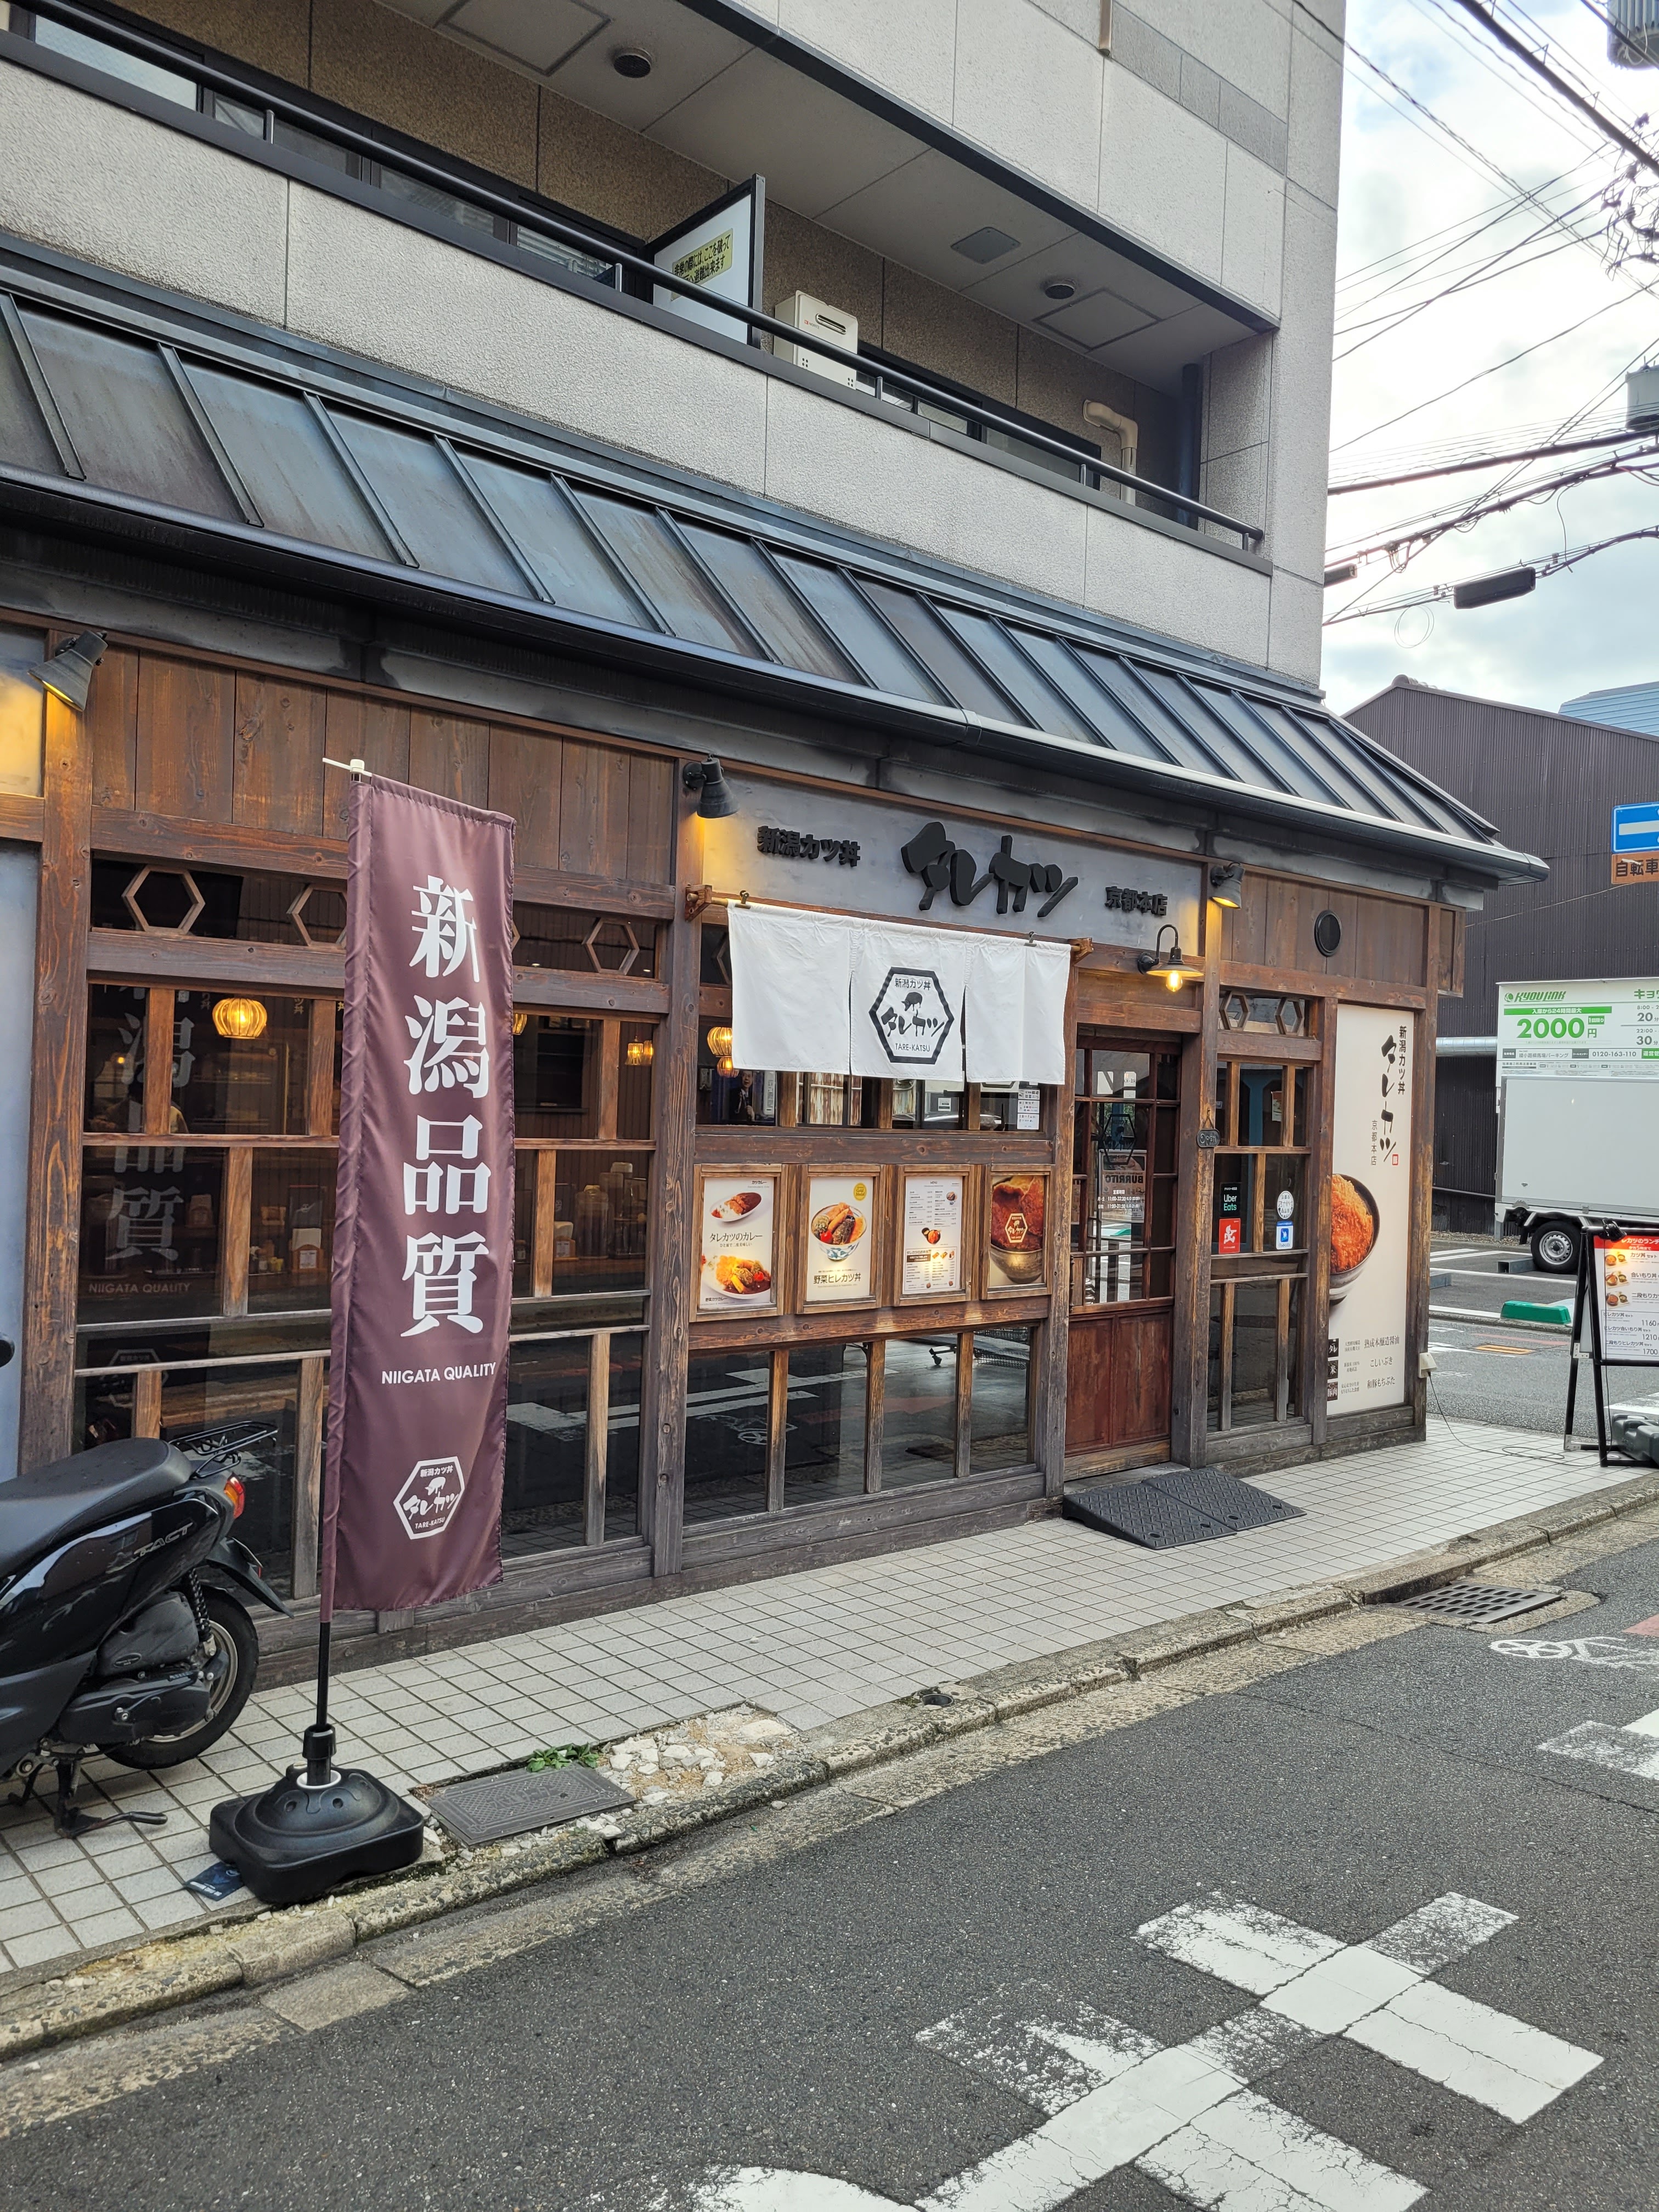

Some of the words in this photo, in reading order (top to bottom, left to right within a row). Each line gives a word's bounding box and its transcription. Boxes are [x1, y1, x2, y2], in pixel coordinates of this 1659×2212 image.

[757, 825, 861, 867] 新潟カツ丼
[901, 821, 1079, 917] タレカツ
[1105, 885, 1168, 916] 京都本店
[894, 978, 931, 991] 新潟カツ丼
[1634, 989, 1659, 999] キョ
[881, 1007, 944, 1037] タレカツ
[1516, 1018, 1584, 1038] 2000
[895, 1043, 930, 1052] TARE-KATSU
[1398, 1025, 1407, 1095] 新潟カツ丼
[1380, 1035, 1396, 1162] タレカツ
[401, 874, 490, 1338] 新潟品質
[1223, 1194, 1238, 1203] Uber
[1223, 1203, 1237, 1211] Eats
[709, 1232, 763, 1243] タレカツのカレー
[813, 1273, 861, 1284] 野菜ヒレカツ丼
[89, 1283, 138, 1293] NIIGATA
[142, 1282, 191, 1293] QUALITY
[1370, 1356, 1393, 1367] こしいぶき
[381, 1368, 441, 1385] NIIGATA
[444, 1362, 496, 1381] QUALITY
[1329, 1365, 1336, 1375] 米
[1367, 1376, 1395, 1389] 和豚もちぶた
[420, 1465, 454, 1478] 新潟カツ丼
[403, 1491, 459, 1520] タレカツ
[415, 1516, 445, 1530] TARE-KATSU
[133, 1521, 194, 1558] TACT
